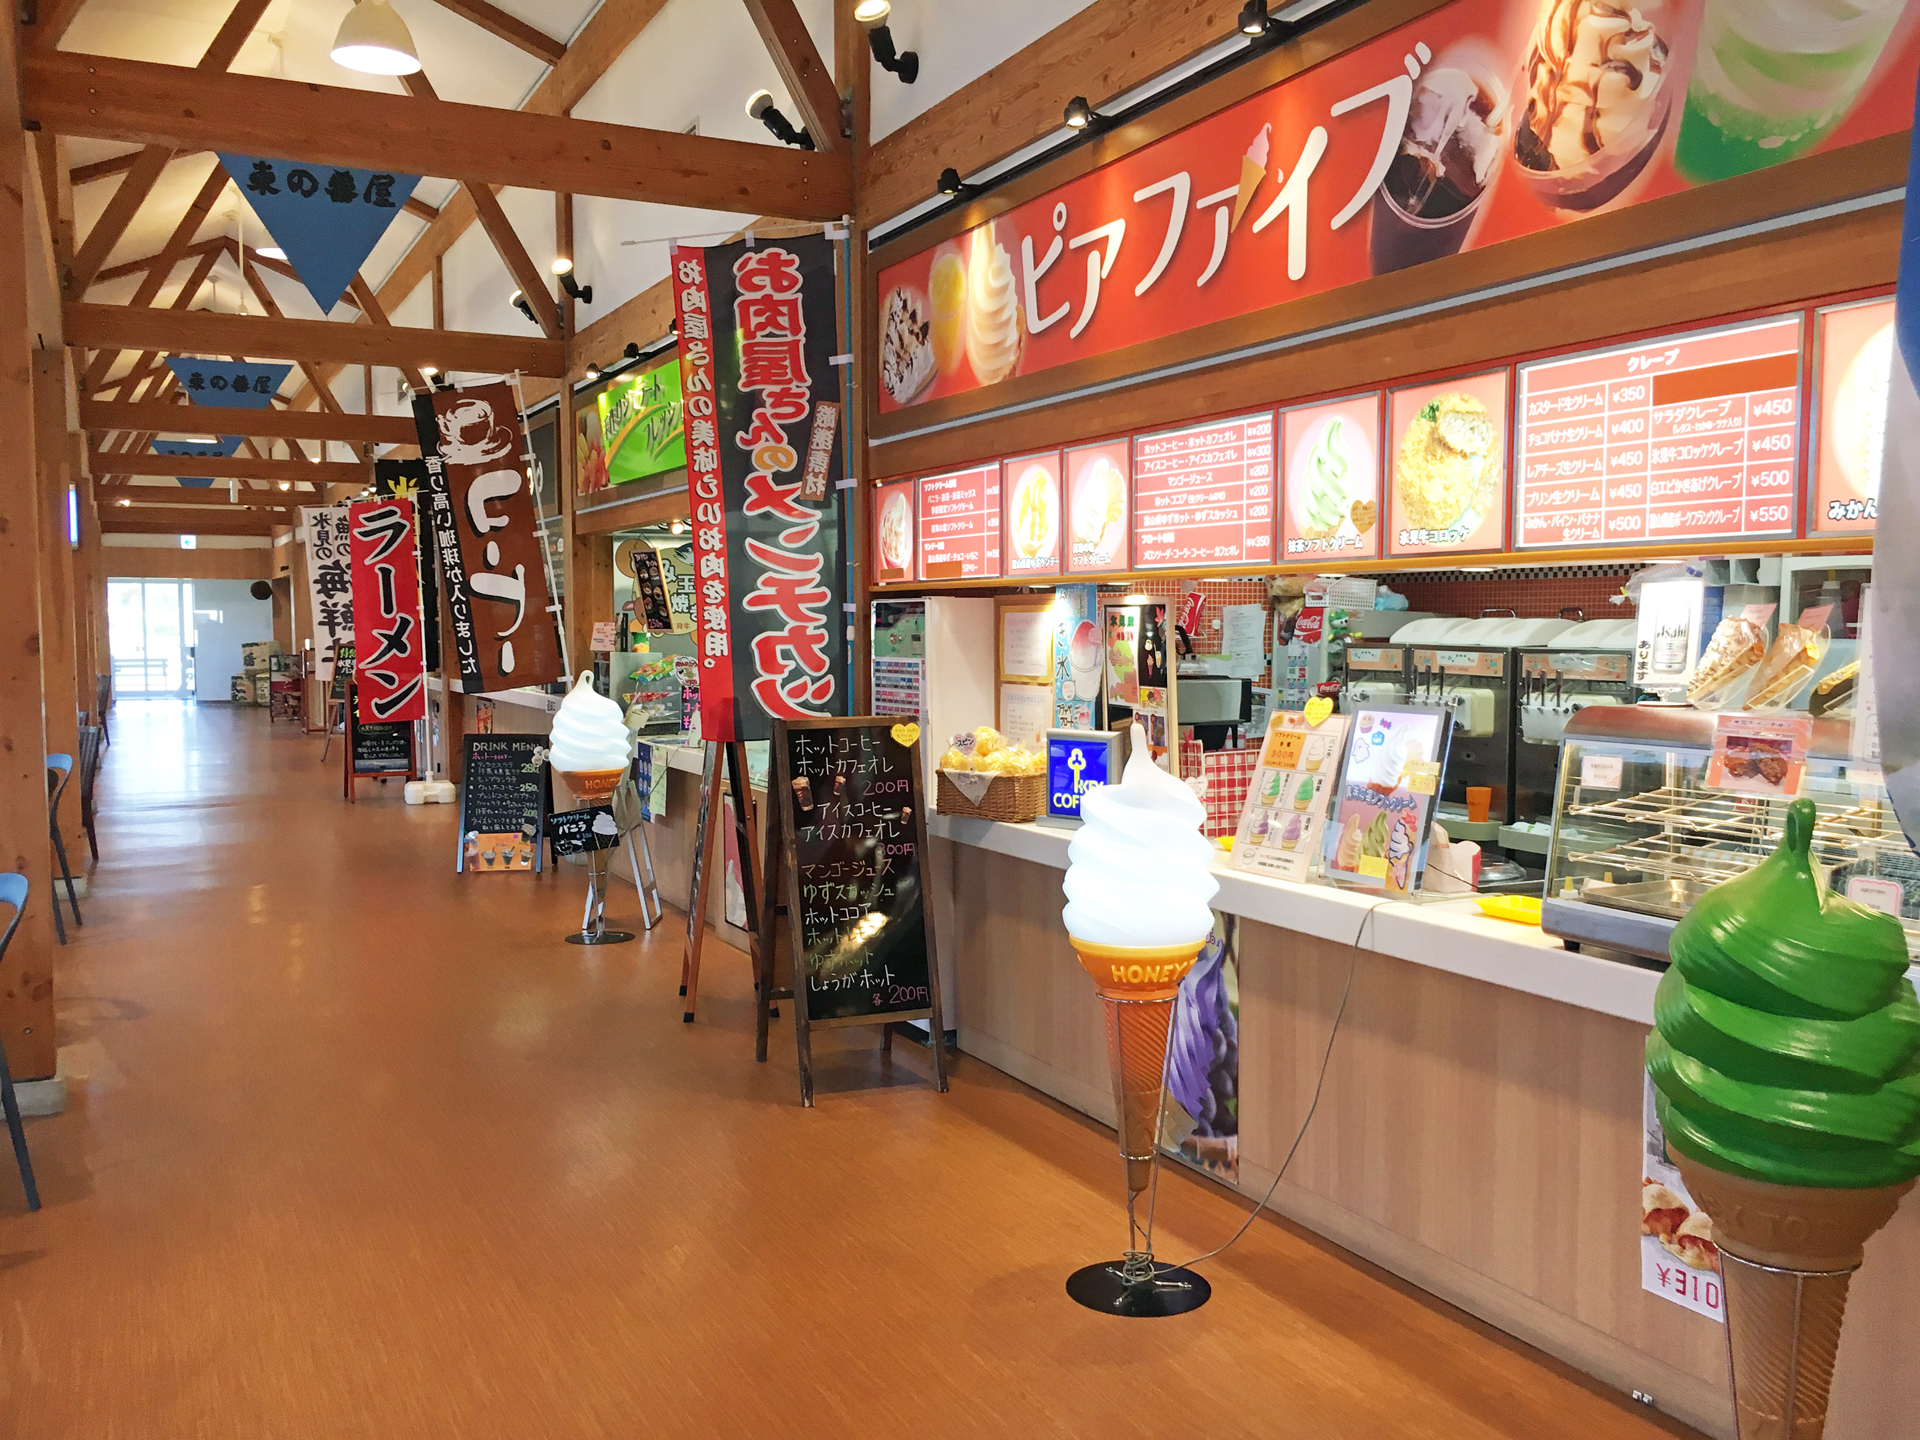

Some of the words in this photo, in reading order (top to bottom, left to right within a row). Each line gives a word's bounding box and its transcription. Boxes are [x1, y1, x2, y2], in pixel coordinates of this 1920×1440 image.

[1021, 41, 1432, 338] ピアファイブ
[1627, 347, 1680, 373] クレープ
[1528, 392, 1604, 416] カスタード生クリーム
[1612, 385, 1645, 403] ¥350
[1652, 400, 1732, 425] サラダクレープ
[1753, 398, 1793, 417] ¥450
[1527, 425, 1604, 447] チョコバナナ生クリーム
[1611, 418, 1645, 435] ¥400
[1651, 438, 1744, 465] 氷見牛コロッケクレープ
[1752, 434, 1791, 452] ¥450
[1526, 458, 1603, 478] レアチーズ生クリーム
[1610, 450, 1644, 467] ¥450
[1167, 472, 1213, 487] マンゴージュース
[1249, 464, 1269, 477] ¥200
[1650, 472, 1743, 496] 白エビかきあげクレープ
[1751, 469, 1790, 487] ¥500
[1249, 484, 1268, 497] ¥200
[1525, 487, 1600, 508] プリン生クリーム
[1609, 482, 1643, 499] ¥450
[1249, 504, 1268, 517] ¥200
[1749, 505, 1789, 522] ¥550
[1399, 526, 1470, 546] 氷見牛コロッケ
[1562, 527, 1601, 542] 生クリーム
[1608, 516, 1642, 531] ¥500
[1287, 535, 1364, 554] 抹茶ソフトクリーム
[353, 505, 422, 719] ラーメン
[1656, 624, 1687, 638] Asahi
[1666, 642, 1675, 651] 生
[1636, 640, 1651, 681] あります
[473, 742, 509, 752] DRINK
[795, 735, 881, 755] ホットコーヒー
[1270, 749, 1295, 761] 300円
[796, 755, 894, 776] ホットカフェオレ
[863, 780, 909, 796] 200円
[1410, 776, 1435, 791] ¥350
[550, 813, 591, 825] ソフトクリーム
[817, 802, 892, 820] アイスコーヒー
[558, 821, 587, 835] バニラ
[801, 820, 900, 842] アイスカフェオレ
[802, 858, 895, 879] マンゴージュース
[803, 881, 895, 904] ゆずスカッシュ
[805, 902, 872, 925] ホットココア
[811, 964, 896, 992] しょうがホット
[1111, 962, 1187, 984] HONEY
[888, 984, 929, 1004] 200円
[1656, 1263, 1719, 1309] ¥310
